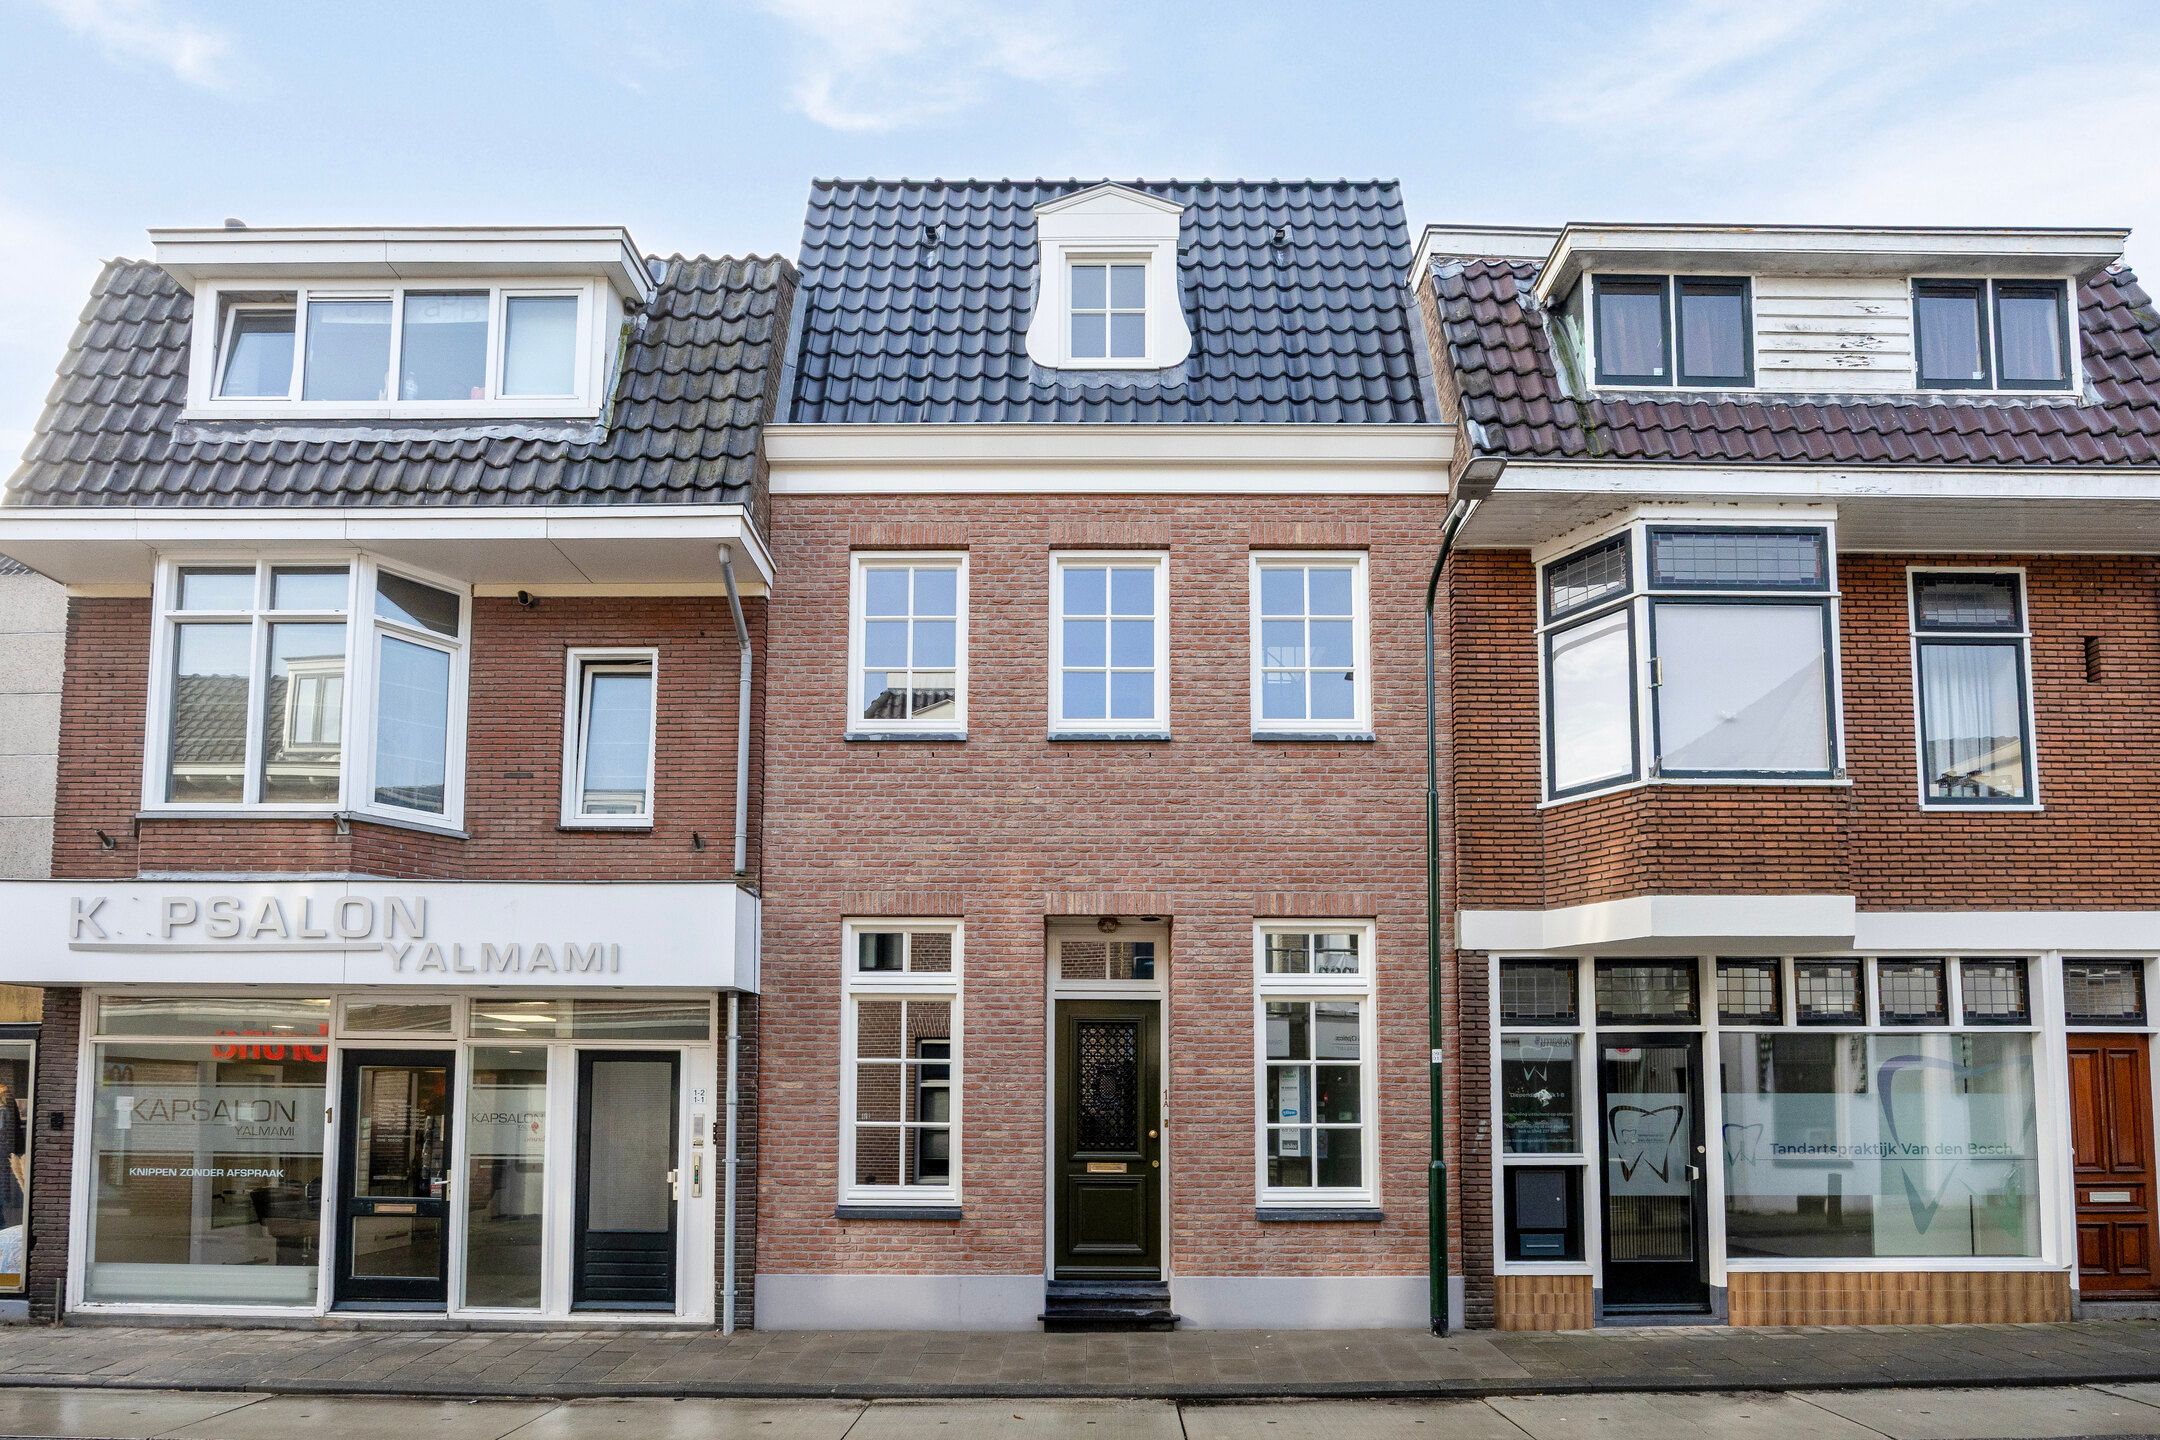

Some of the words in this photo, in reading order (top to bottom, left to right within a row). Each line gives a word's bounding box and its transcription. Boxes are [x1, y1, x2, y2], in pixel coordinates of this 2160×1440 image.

[69, 896, 426, 938] KPSALON
[384, 942, 619, 972] YALMAMI
[234, 1126, 295, 1136] YALMAMI
[1770, 1142, 1897, 1158] Tandartspraktijk
[1901, 1142, 1930, 1155] Van
[1934, 1142, 1963, 1155] den
[1968, 1142, 2013, 1155] Bosch
[129, 1167, 177, 1177] KNIPPEN
[179, 1168, 224, 1177] ZONDER
[226, 1168, 284, 1178] AFSPRAAK
